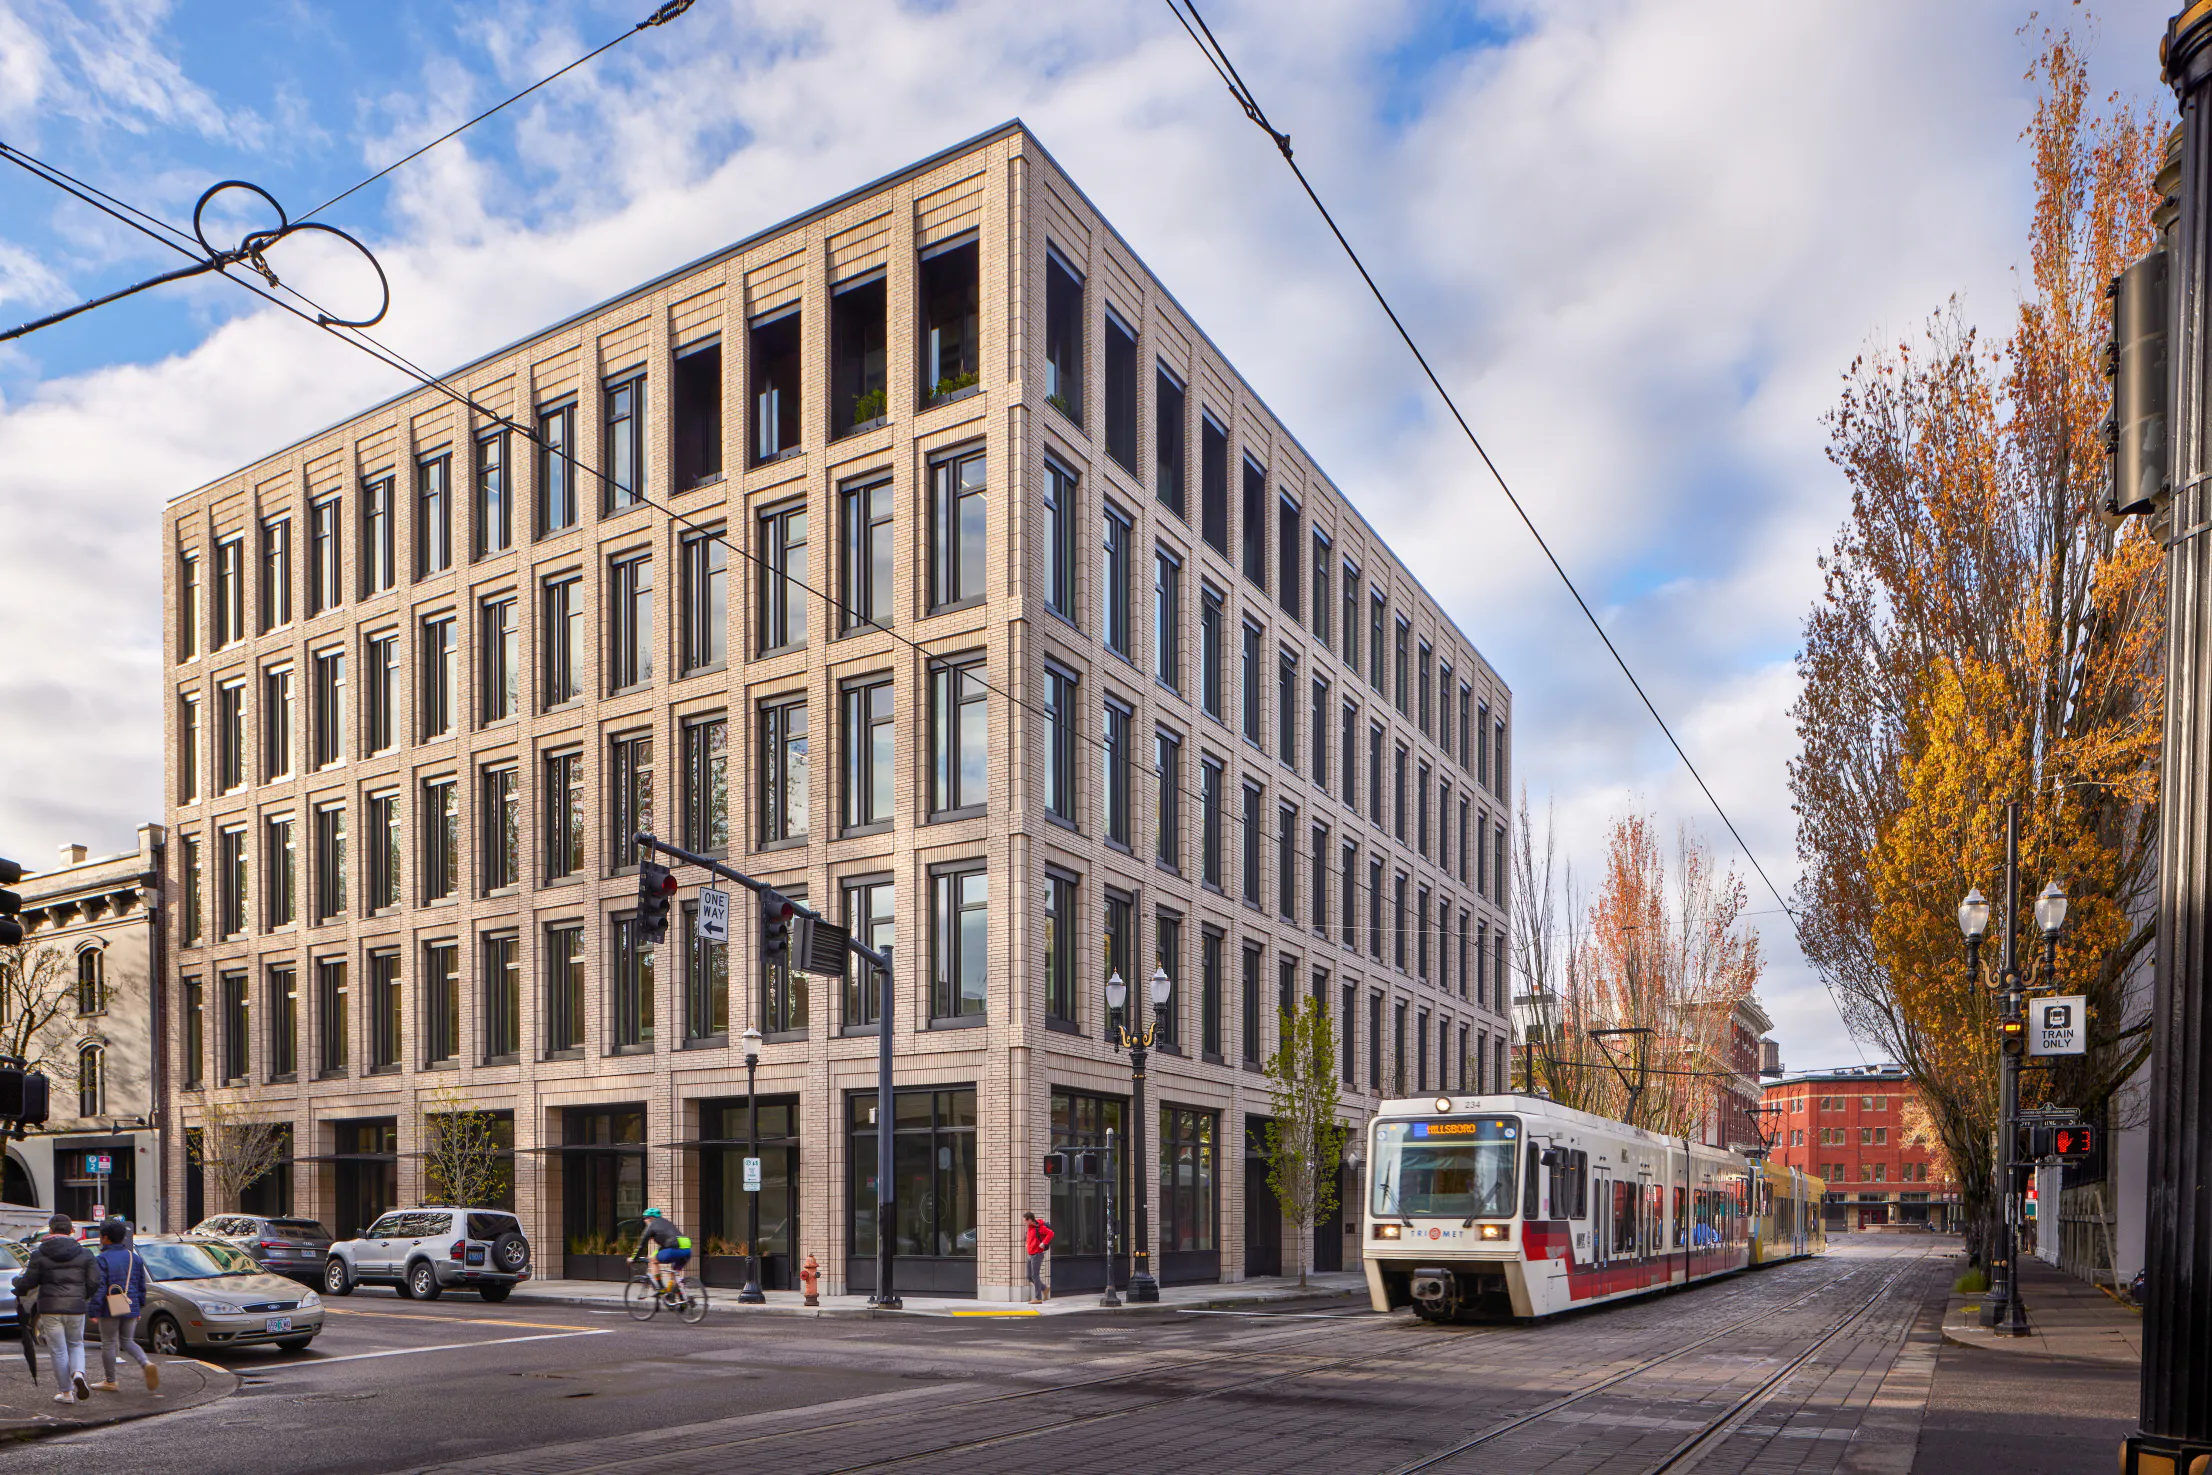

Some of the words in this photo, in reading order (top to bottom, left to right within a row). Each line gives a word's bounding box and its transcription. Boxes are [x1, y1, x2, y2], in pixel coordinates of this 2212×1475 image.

[704, 892, 725, 907] ONE
[703, 905, 725, 920] WAY
[2041, 1029, 2074, 1040] TRAIN
[2042, 1038, 2072, 1049] ONLY
[1464, 1101, 1481, 1110] 234
[1427, 1123, 1477, 1135] HILLSBORO
